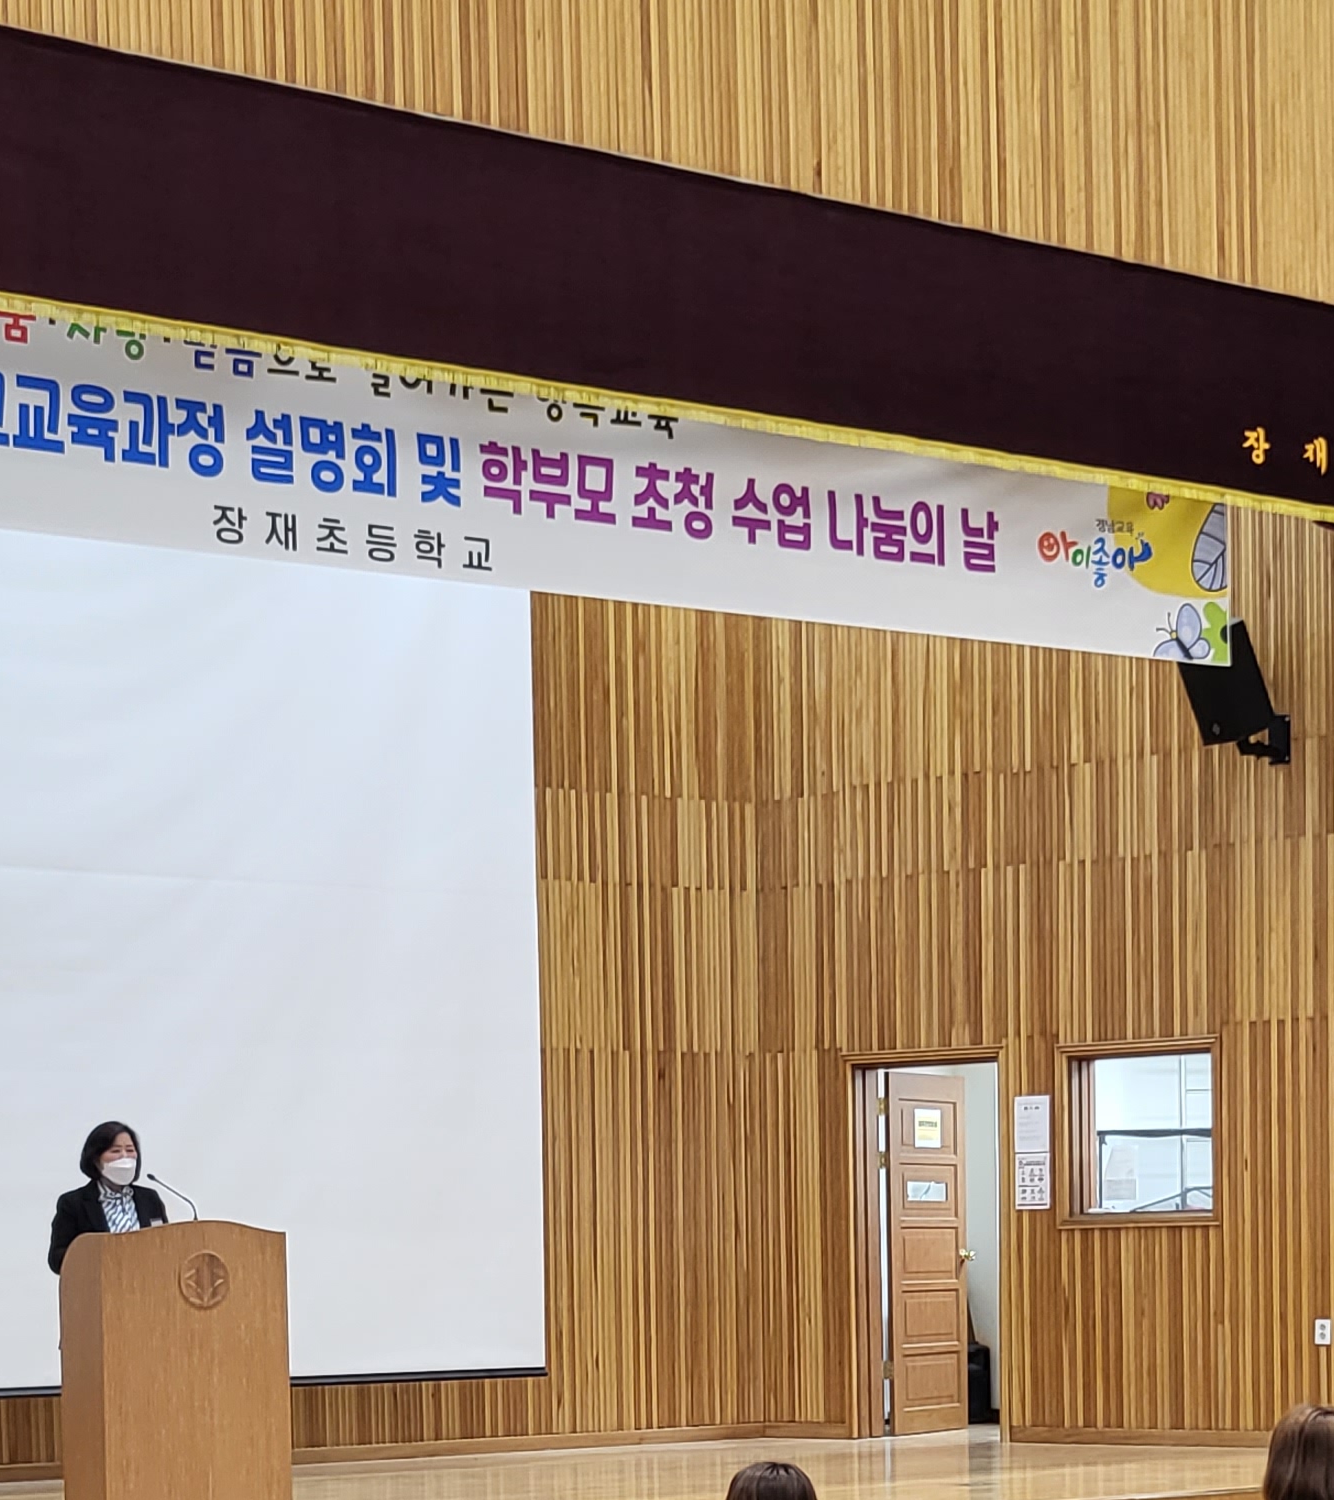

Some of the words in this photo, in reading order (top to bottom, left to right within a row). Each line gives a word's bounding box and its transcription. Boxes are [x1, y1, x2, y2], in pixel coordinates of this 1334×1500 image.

[213, 503, 495, 572] 장재초등학교
[245, 408, 399, 498] 설명회
[416, 432, 462, 508] 및
[478, 440, 617, 526] 학부모
[631, 462, 715, 540] 초청
[732, 477, 812, 551] 수업
[827, 489, 946, 567] 나눔의
[960, 507, 1000, 573] 날
